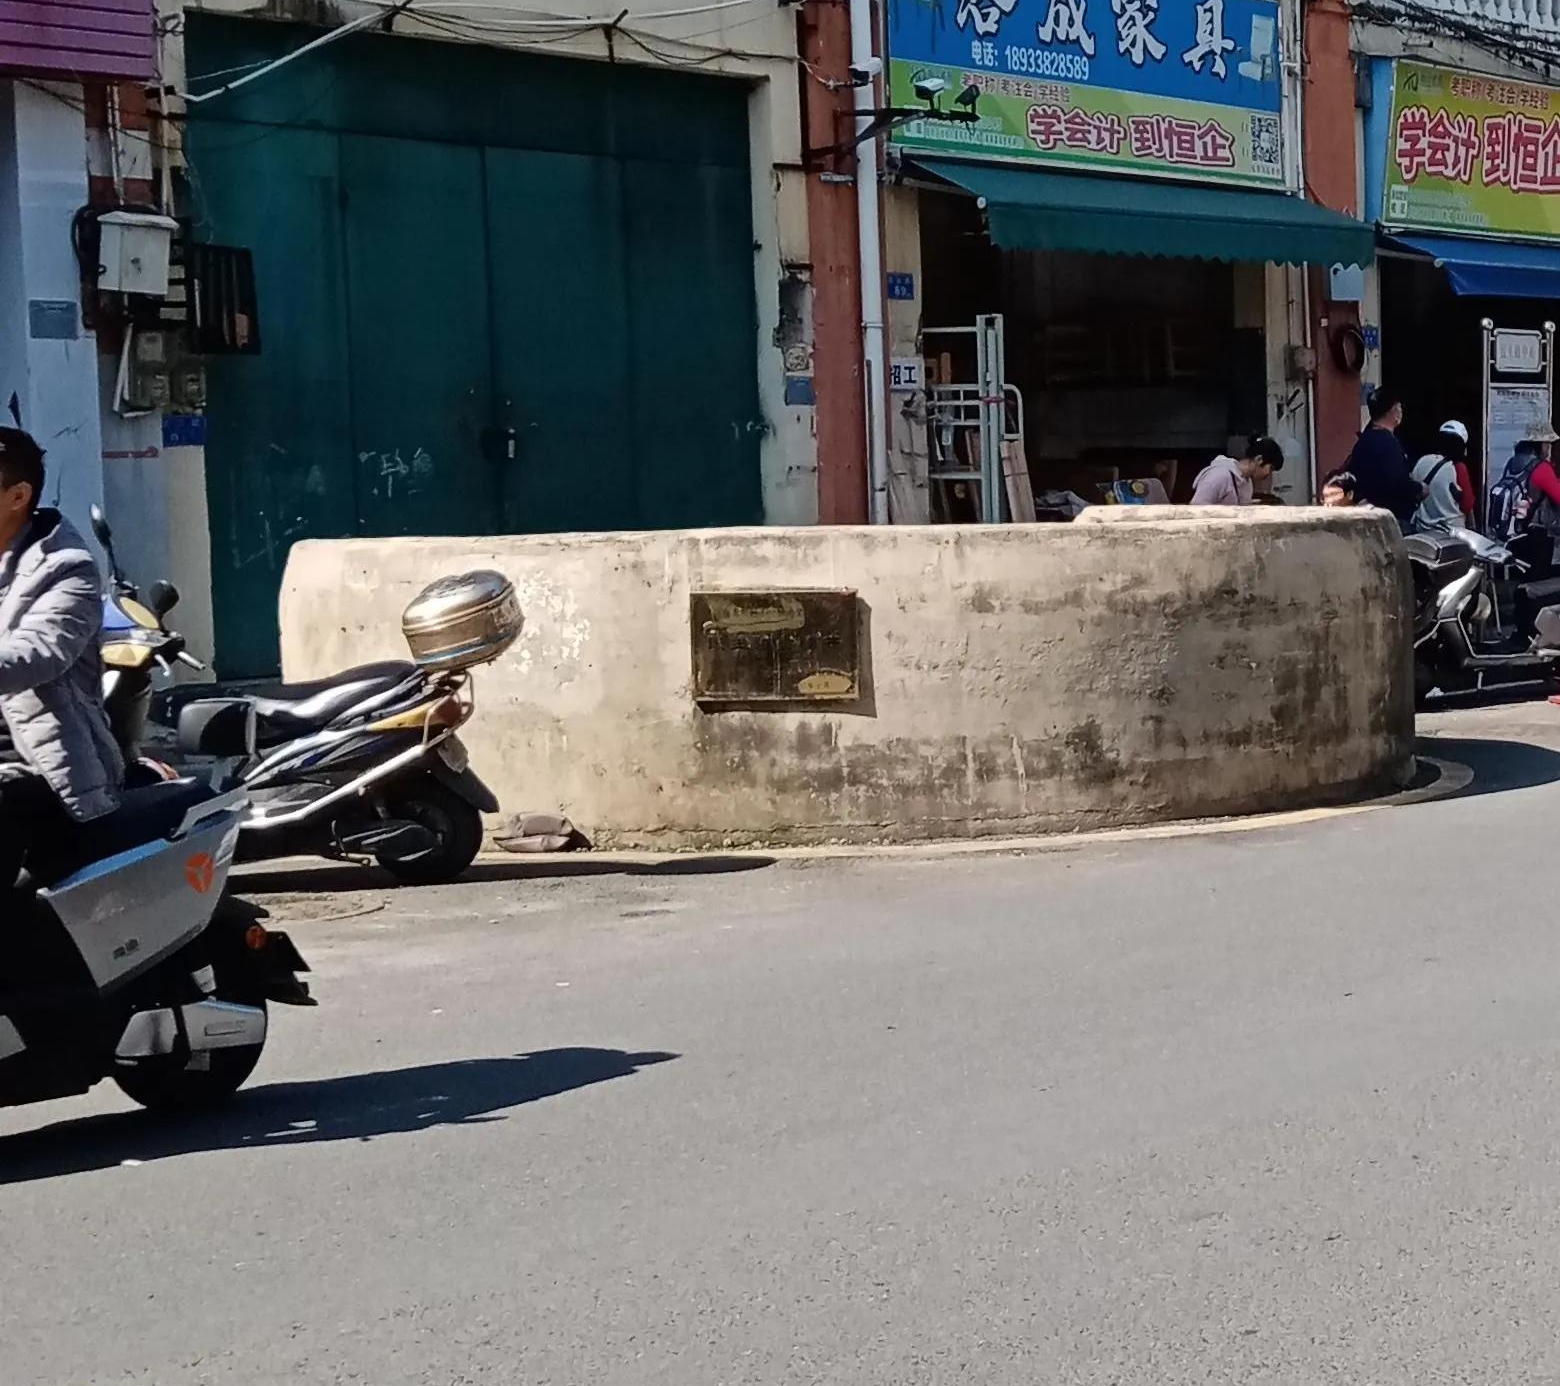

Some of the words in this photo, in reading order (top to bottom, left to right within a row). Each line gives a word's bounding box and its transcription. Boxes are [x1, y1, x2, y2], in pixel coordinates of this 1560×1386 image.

[1004, 44, 1090, 81] 18933828589
[1026, 104, 1127, 155] 学会计
[1128, 114, 1236, 167] 到恒企
[1396, 105, 1481, 186] 学会计
